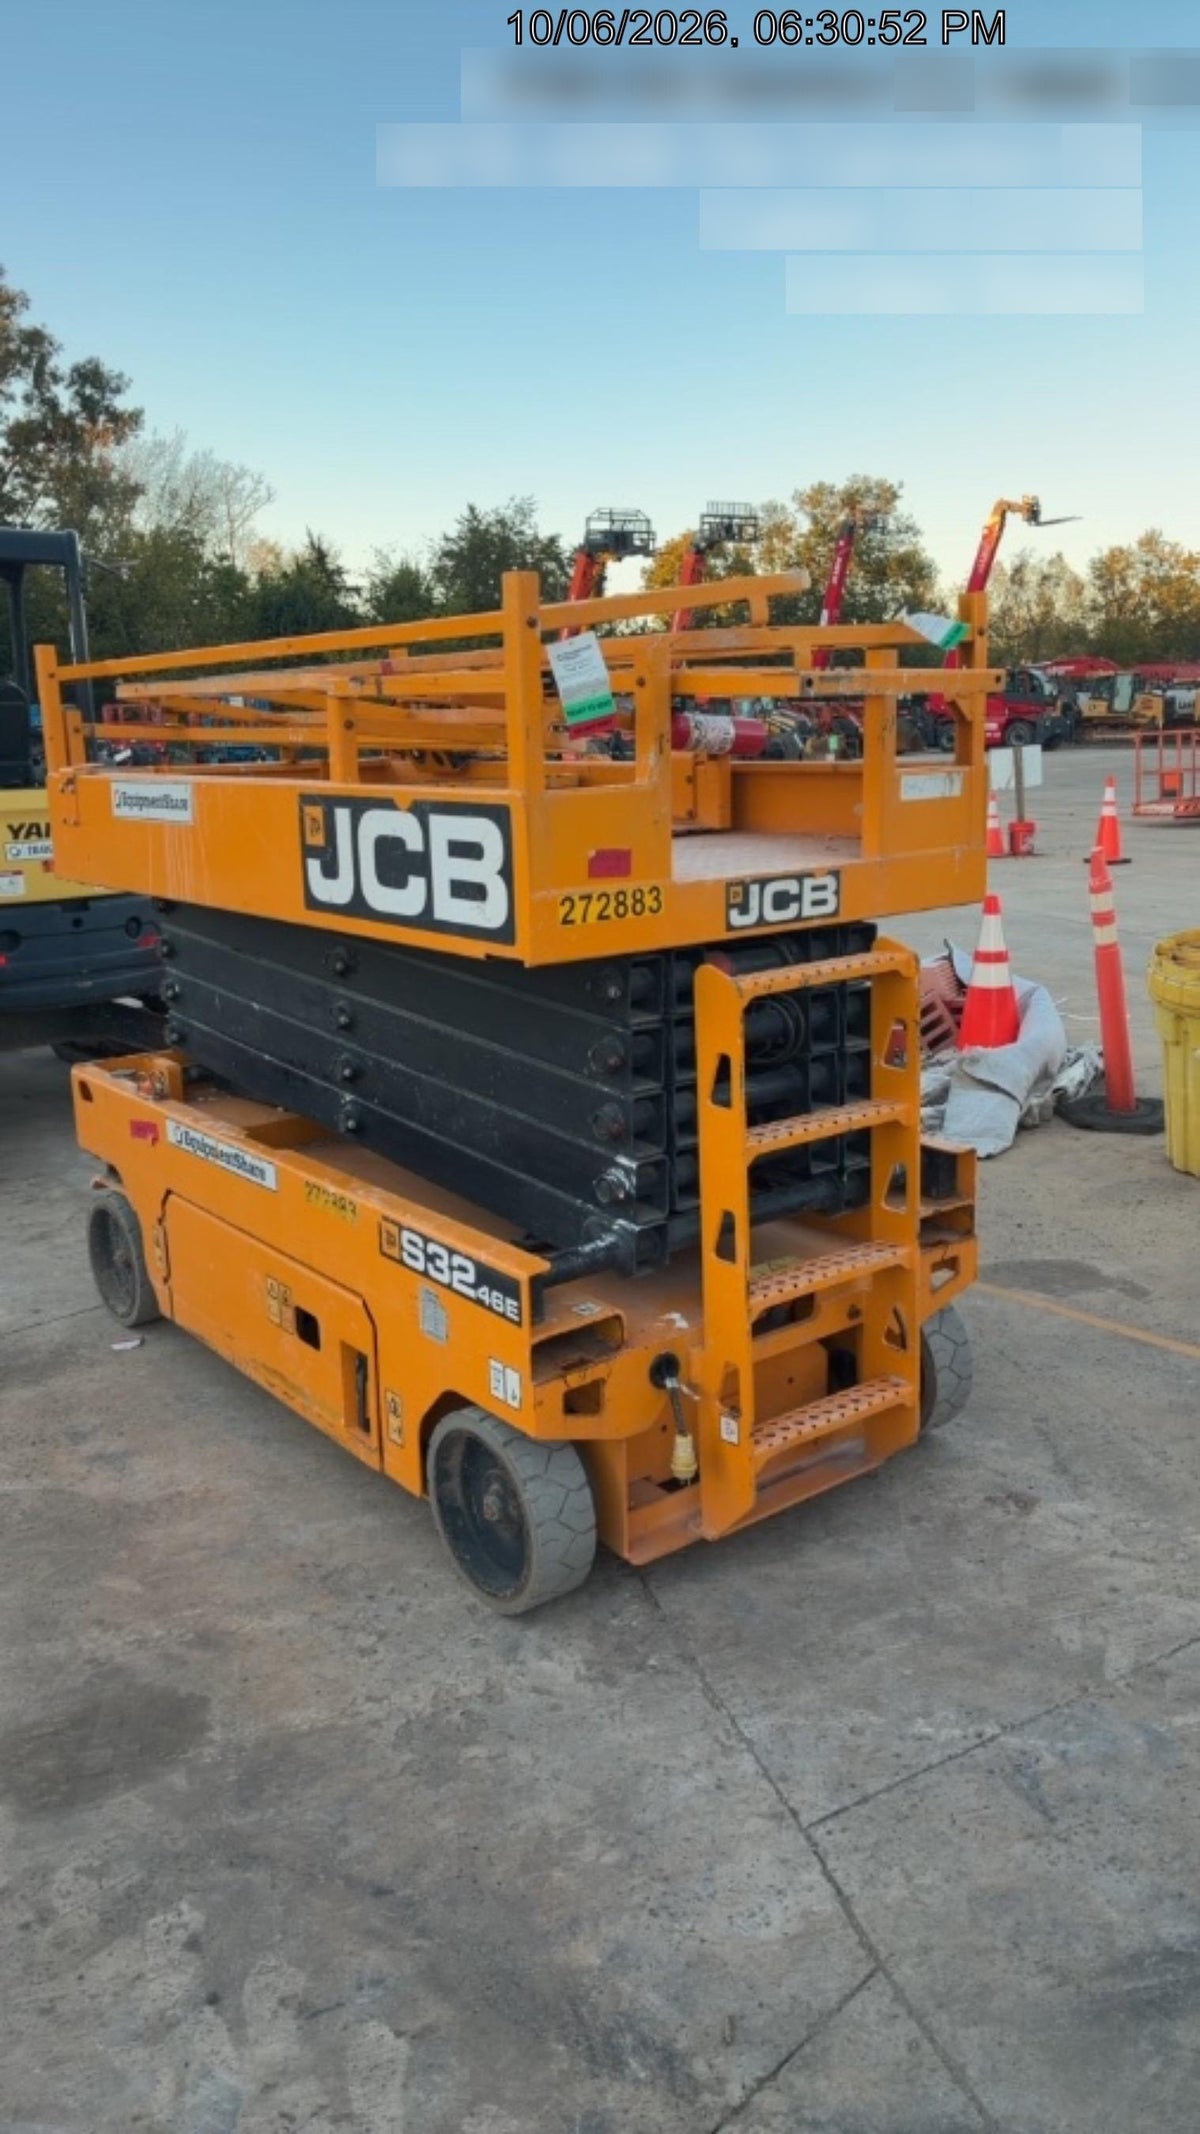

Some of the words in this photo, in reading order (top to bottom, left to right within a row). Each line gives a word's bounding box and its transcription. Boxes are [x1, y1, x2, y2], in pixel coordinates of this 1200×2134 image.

[306, 807, 509, 930] JCB
[560, 886, 663, 926] 272883
[729, 874, 838, 928] JCB
[401, 1228, 476, 1300] S32
